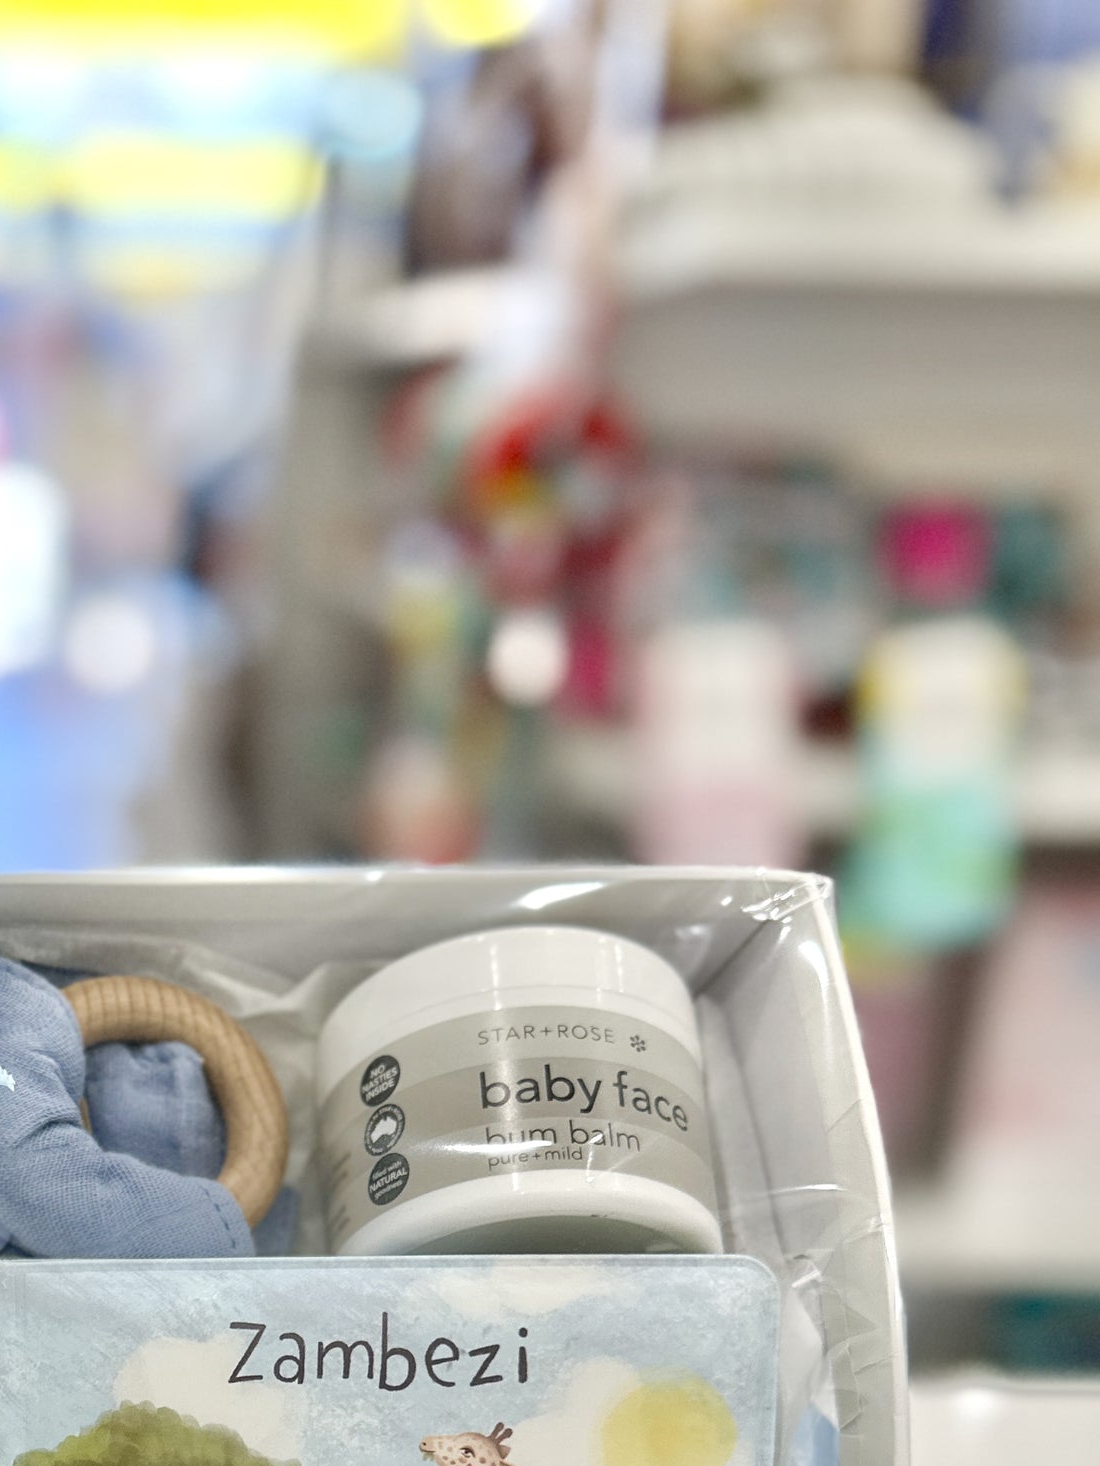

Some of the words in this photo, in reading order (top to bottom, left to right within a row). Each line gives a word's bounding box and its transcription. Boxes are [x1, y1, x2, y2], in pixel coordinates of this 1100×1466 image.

[477, 1025, 616, 1046] STAR+ROSE
[362, 1065, 398, 1094] NASTIES
[370, 1064, 386, 1079] NO
[365, 1078, 396, 1102] INSIDE
[479, 1063, 602, 1114] baby
[612, 1070, 689, 1132] face
[568, 1119, 641, 1152] balm
[370, 1166, 409, 1194] NATURAL
[227, 1311, 529, 1392] Zambezi
